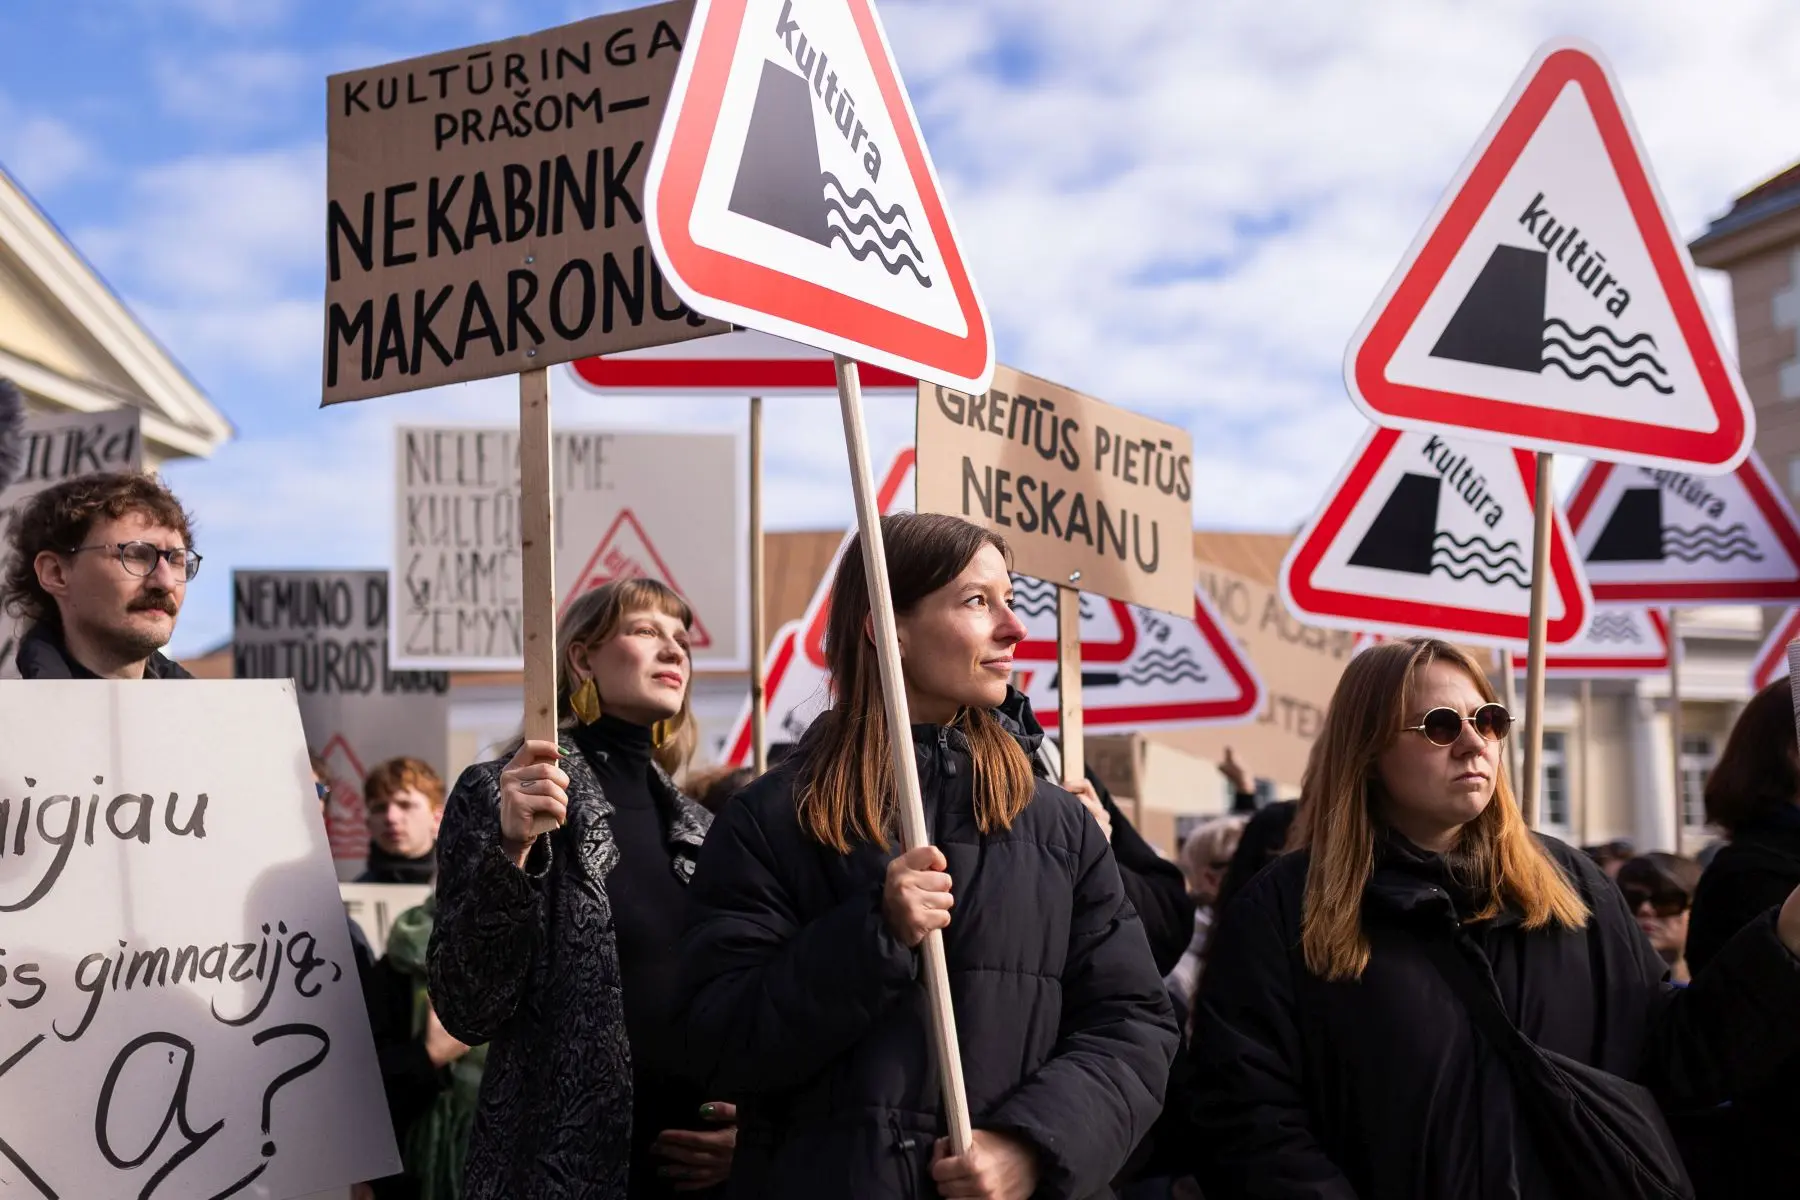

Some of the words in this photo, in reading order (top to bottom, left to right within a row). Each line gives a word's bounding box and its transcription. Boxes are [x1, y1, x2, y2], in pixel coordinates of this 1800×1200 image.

[776, 0, 882, 184] kultūra
[327, 140, 645, 282] NEKABINK
[1518, 192, 1632, 319] kultūra
[935, 383, 1081, 472] GREITŪS
[1094, 425, 1192, 503] PIETŪS
[1422, 434, 1505, 529] kultūra
[961, 456, 1160, 574] NESKANU
[52, 920, 342, 1042] gimnaziją,
